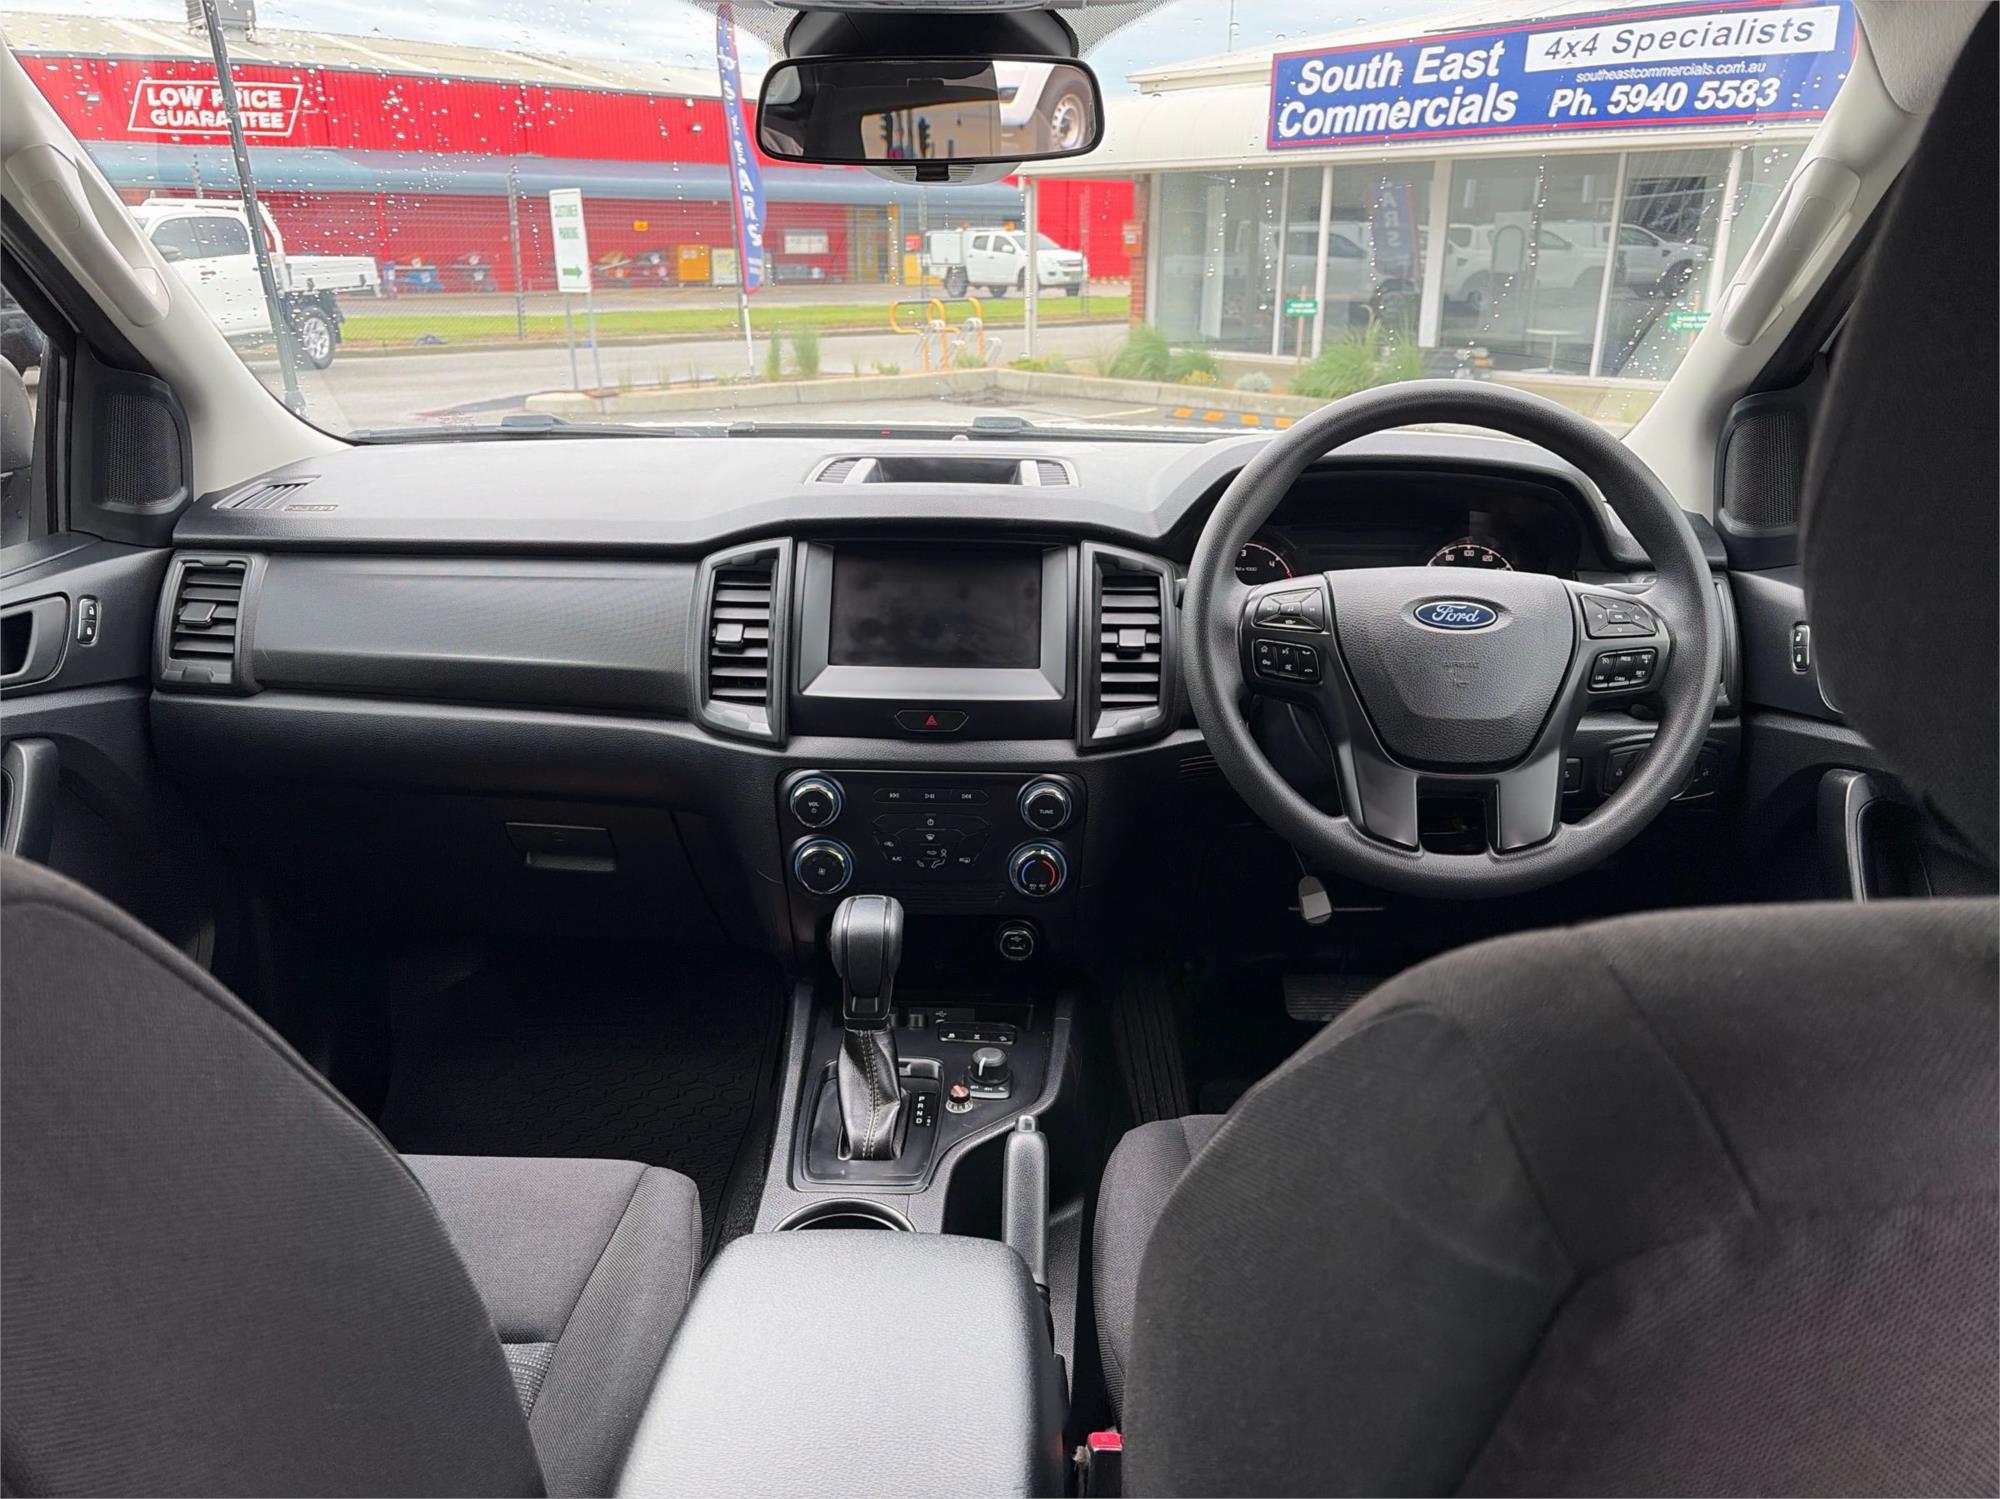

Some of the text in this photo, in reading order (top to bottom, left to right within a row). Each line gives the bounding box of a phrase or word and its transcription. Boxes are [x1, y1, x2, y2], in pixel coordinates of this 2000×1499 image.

[1543, 18, 1816, 59] 4x4 Specialists
[1297, 40, 1505, 96] South East
[1575, 61, 1767, 82] southeastcommercials.com.au
[146, 87, 203, 107] LOW
[1279, 82, 1519, 137] Commercials
[1548, 77, 1780, 117] Ph. 5940 5583
[150, 109, 285, 128] GUARATEE
[1431, 605, 1480, 622] Ford
